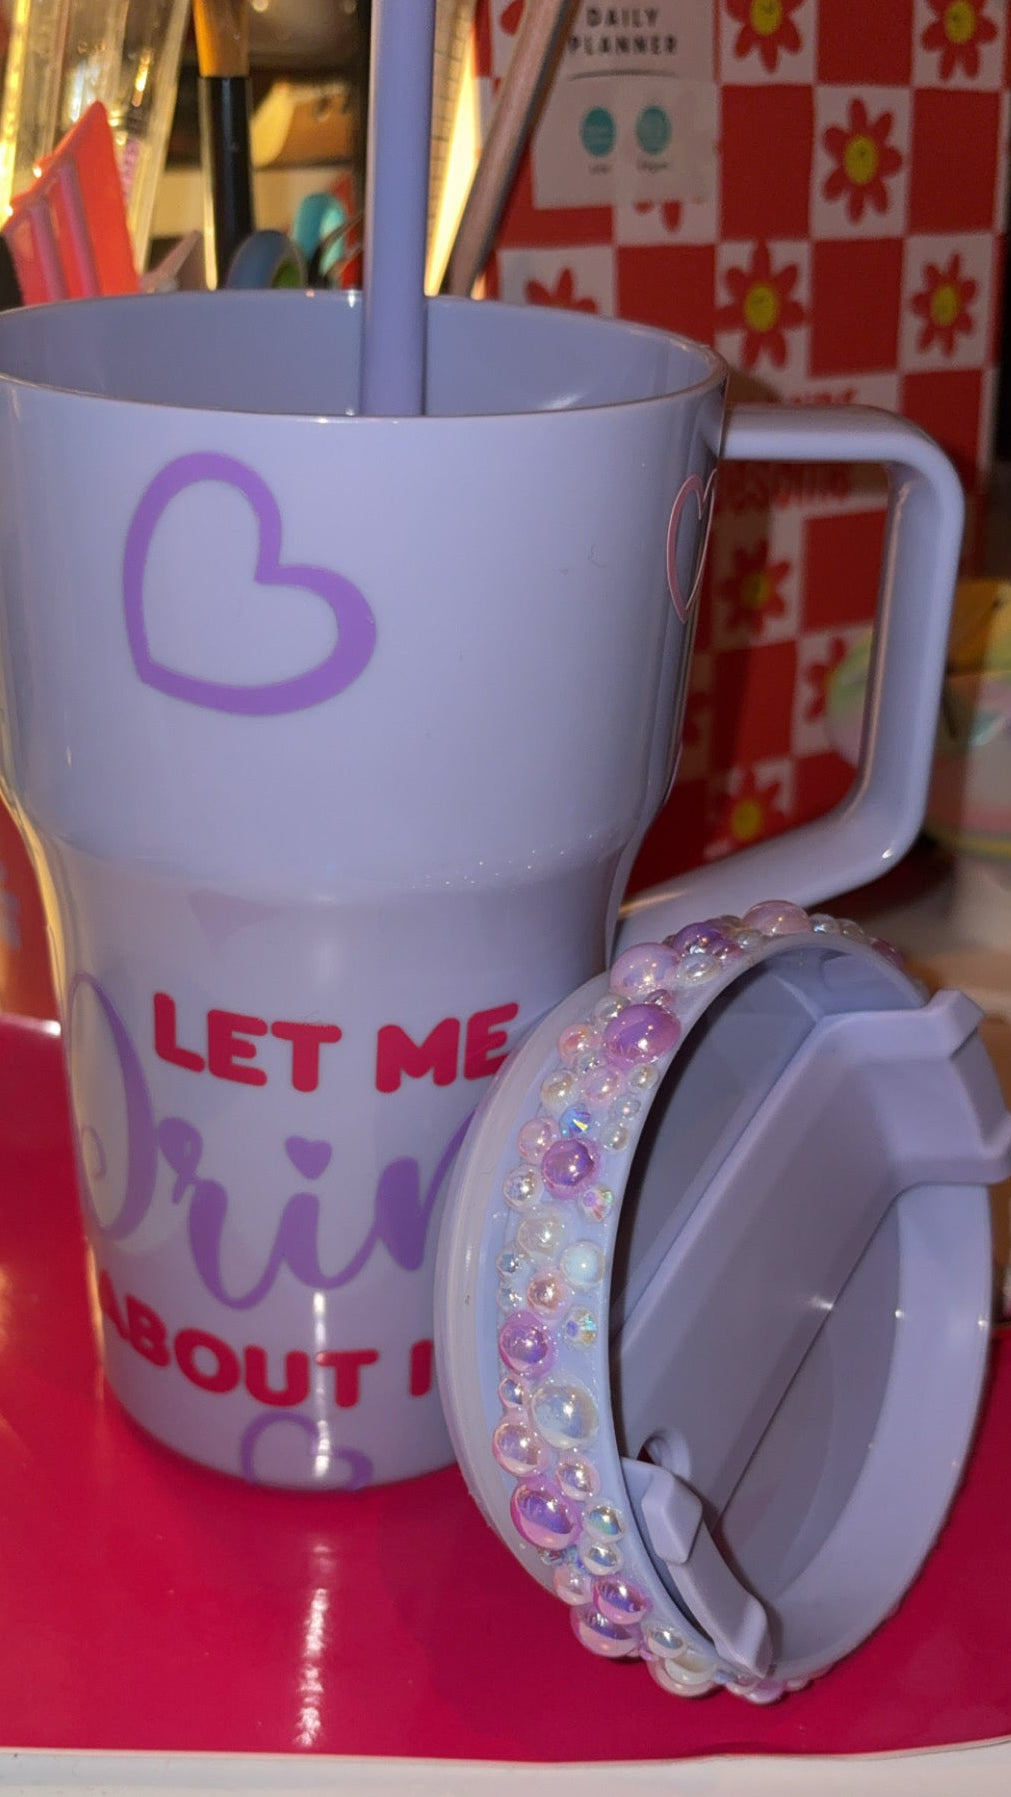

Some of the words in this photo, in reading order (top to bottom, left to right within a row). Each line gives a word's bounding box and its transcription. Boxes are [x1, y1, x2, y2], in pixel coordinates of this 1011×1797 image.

[586, 7, 658, 27] DAILY
[568, 34, 677, 55] PLANNER
[153, 992, 342, 1093] LET
[375, 1002, 519, 1094] ME
